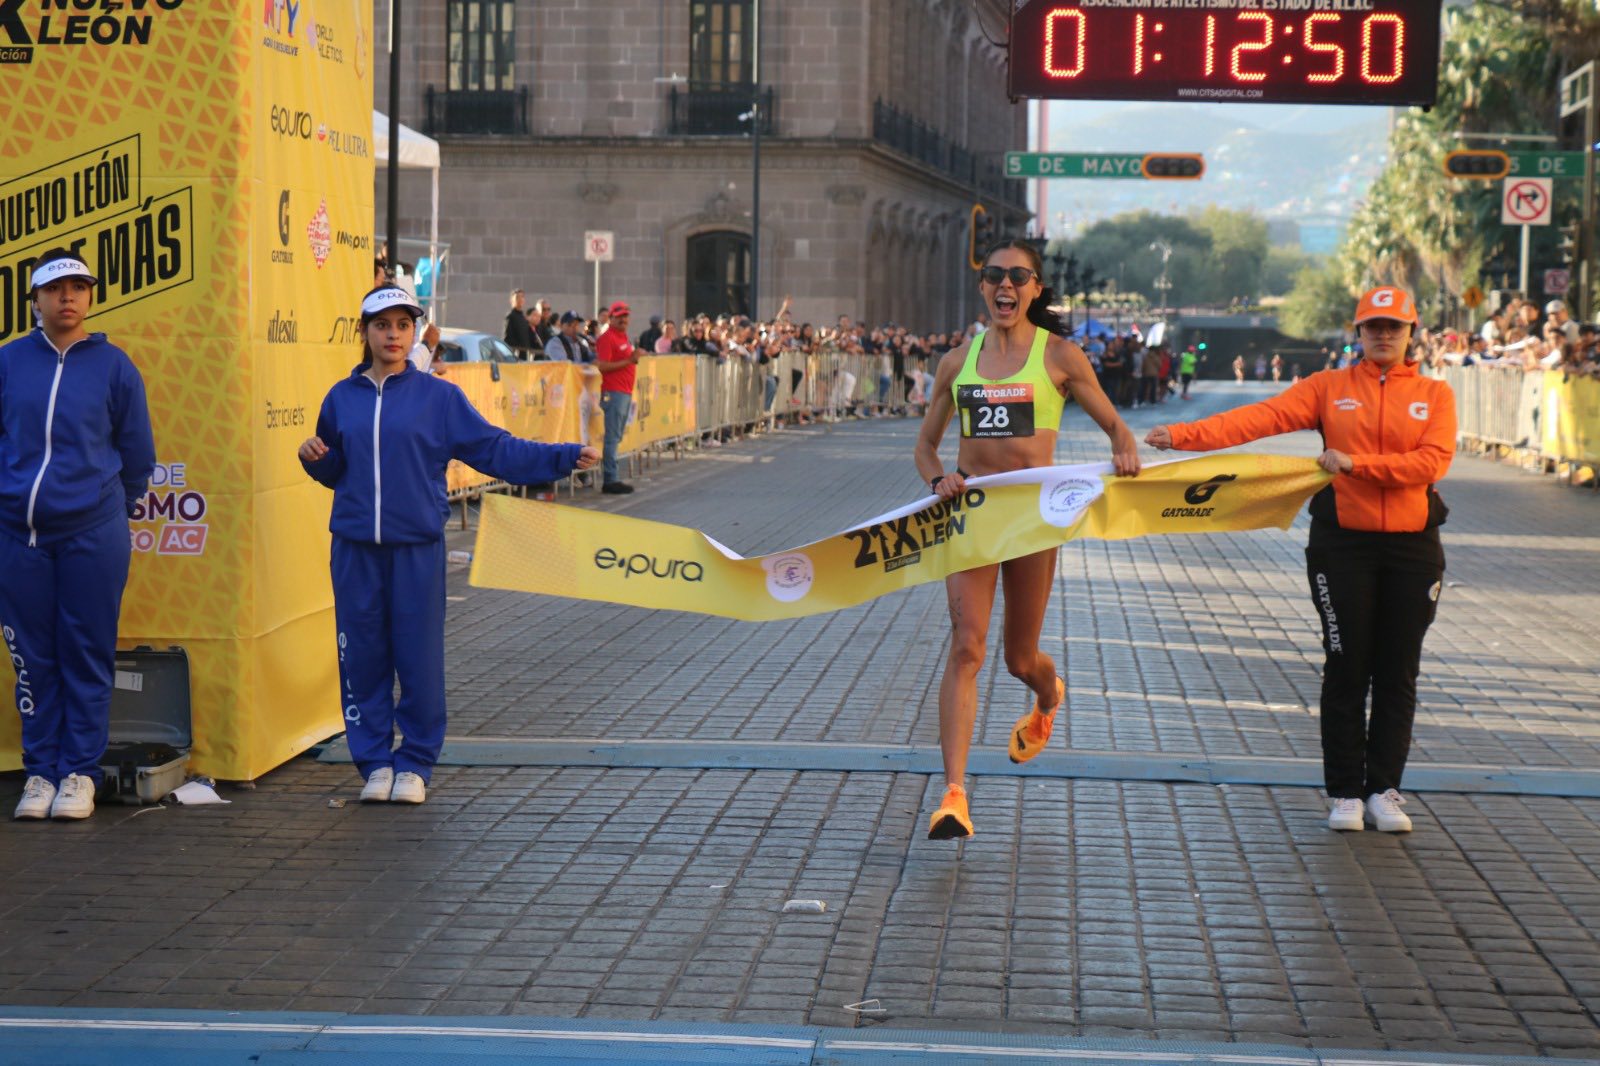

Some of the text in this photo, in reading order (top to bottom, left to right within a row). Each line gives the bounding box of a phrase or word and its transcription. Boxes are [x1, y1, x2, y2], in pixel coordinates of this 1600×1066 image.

[38, 5, 153, 45] LEÓN
[1009, 157, 1143, 174] 5 DE MAYO
[1538, 156, 1566, 174] DE
[73, 150, 129, 218] LEÓN
[97, 196, 181, 304] MÁS
[972, 388, 1026, 398] GATORADE
[977, 406, 1010, 428] 28
[152, 464, 185, 486] DE
[1161, 507, 1215, 518] GATORADE
[165, 529, 199, 549] AC
[1315, 573, 1343, 654] GATORADE
